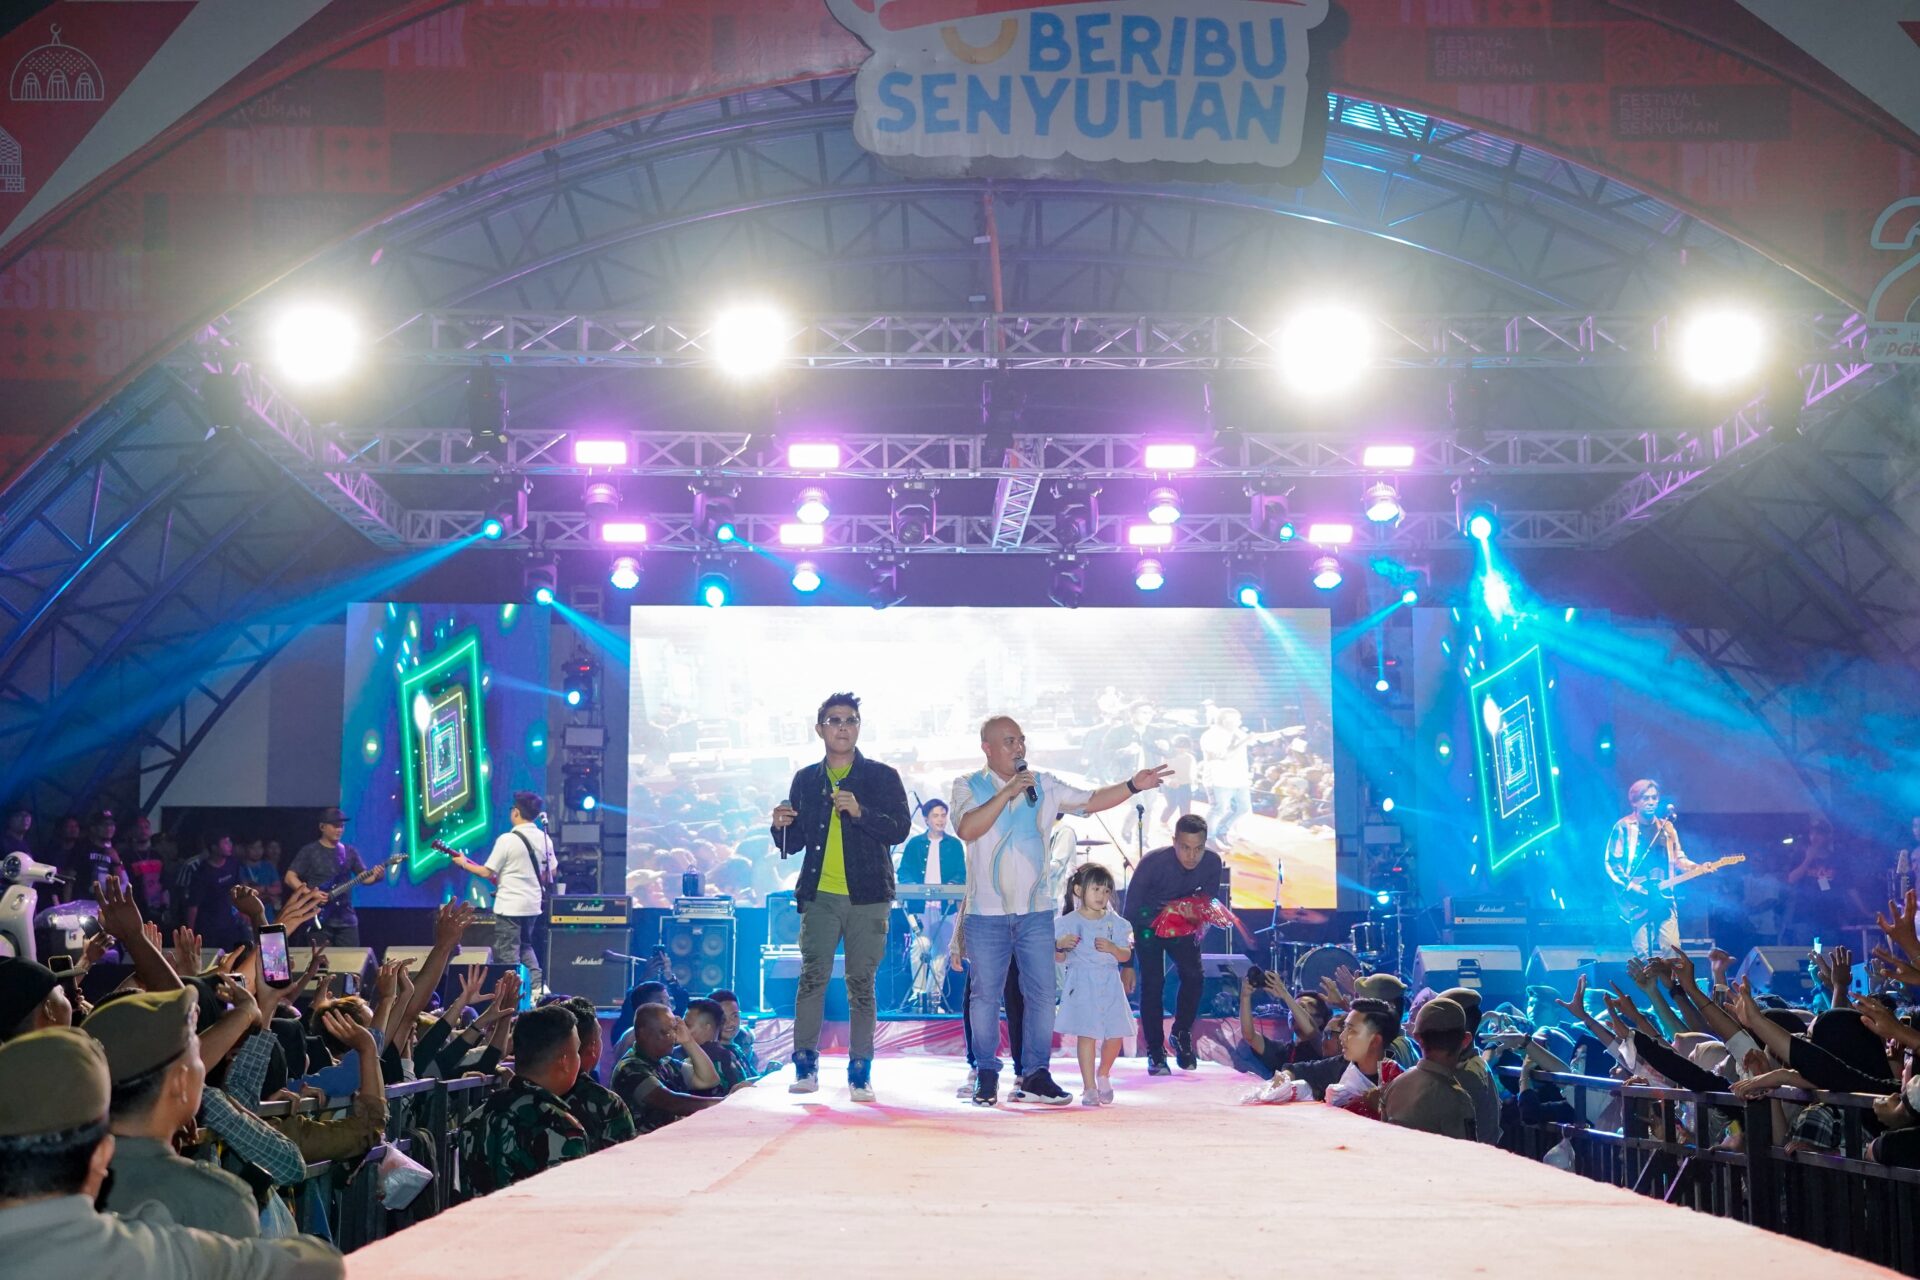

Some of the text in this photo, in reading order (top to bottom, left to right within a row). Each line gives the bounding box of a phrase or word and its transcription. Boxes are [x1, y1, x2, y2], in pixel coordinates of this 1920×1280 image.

[1027, 11, 1287, 80] BERIBU
[1434, 36, 1515, 49] FESTIVAL
[1434, 50, 1498, 62] BERIBU
[1434, 63, 1534, 76] SENYUMAN
[1619, 93, 1702, 106] FESTIVAL
[876, 72, 1286, 145] SENYUMAN
[1619, 107, 1684, 121] BERIBU
[1619, 121, 1720, 135] SENYUMAN
[572, 902, 606, 912] Marshall
[1474, 903, 1506, 913] Marshall
[571, 955, 605, 966] Marshall
